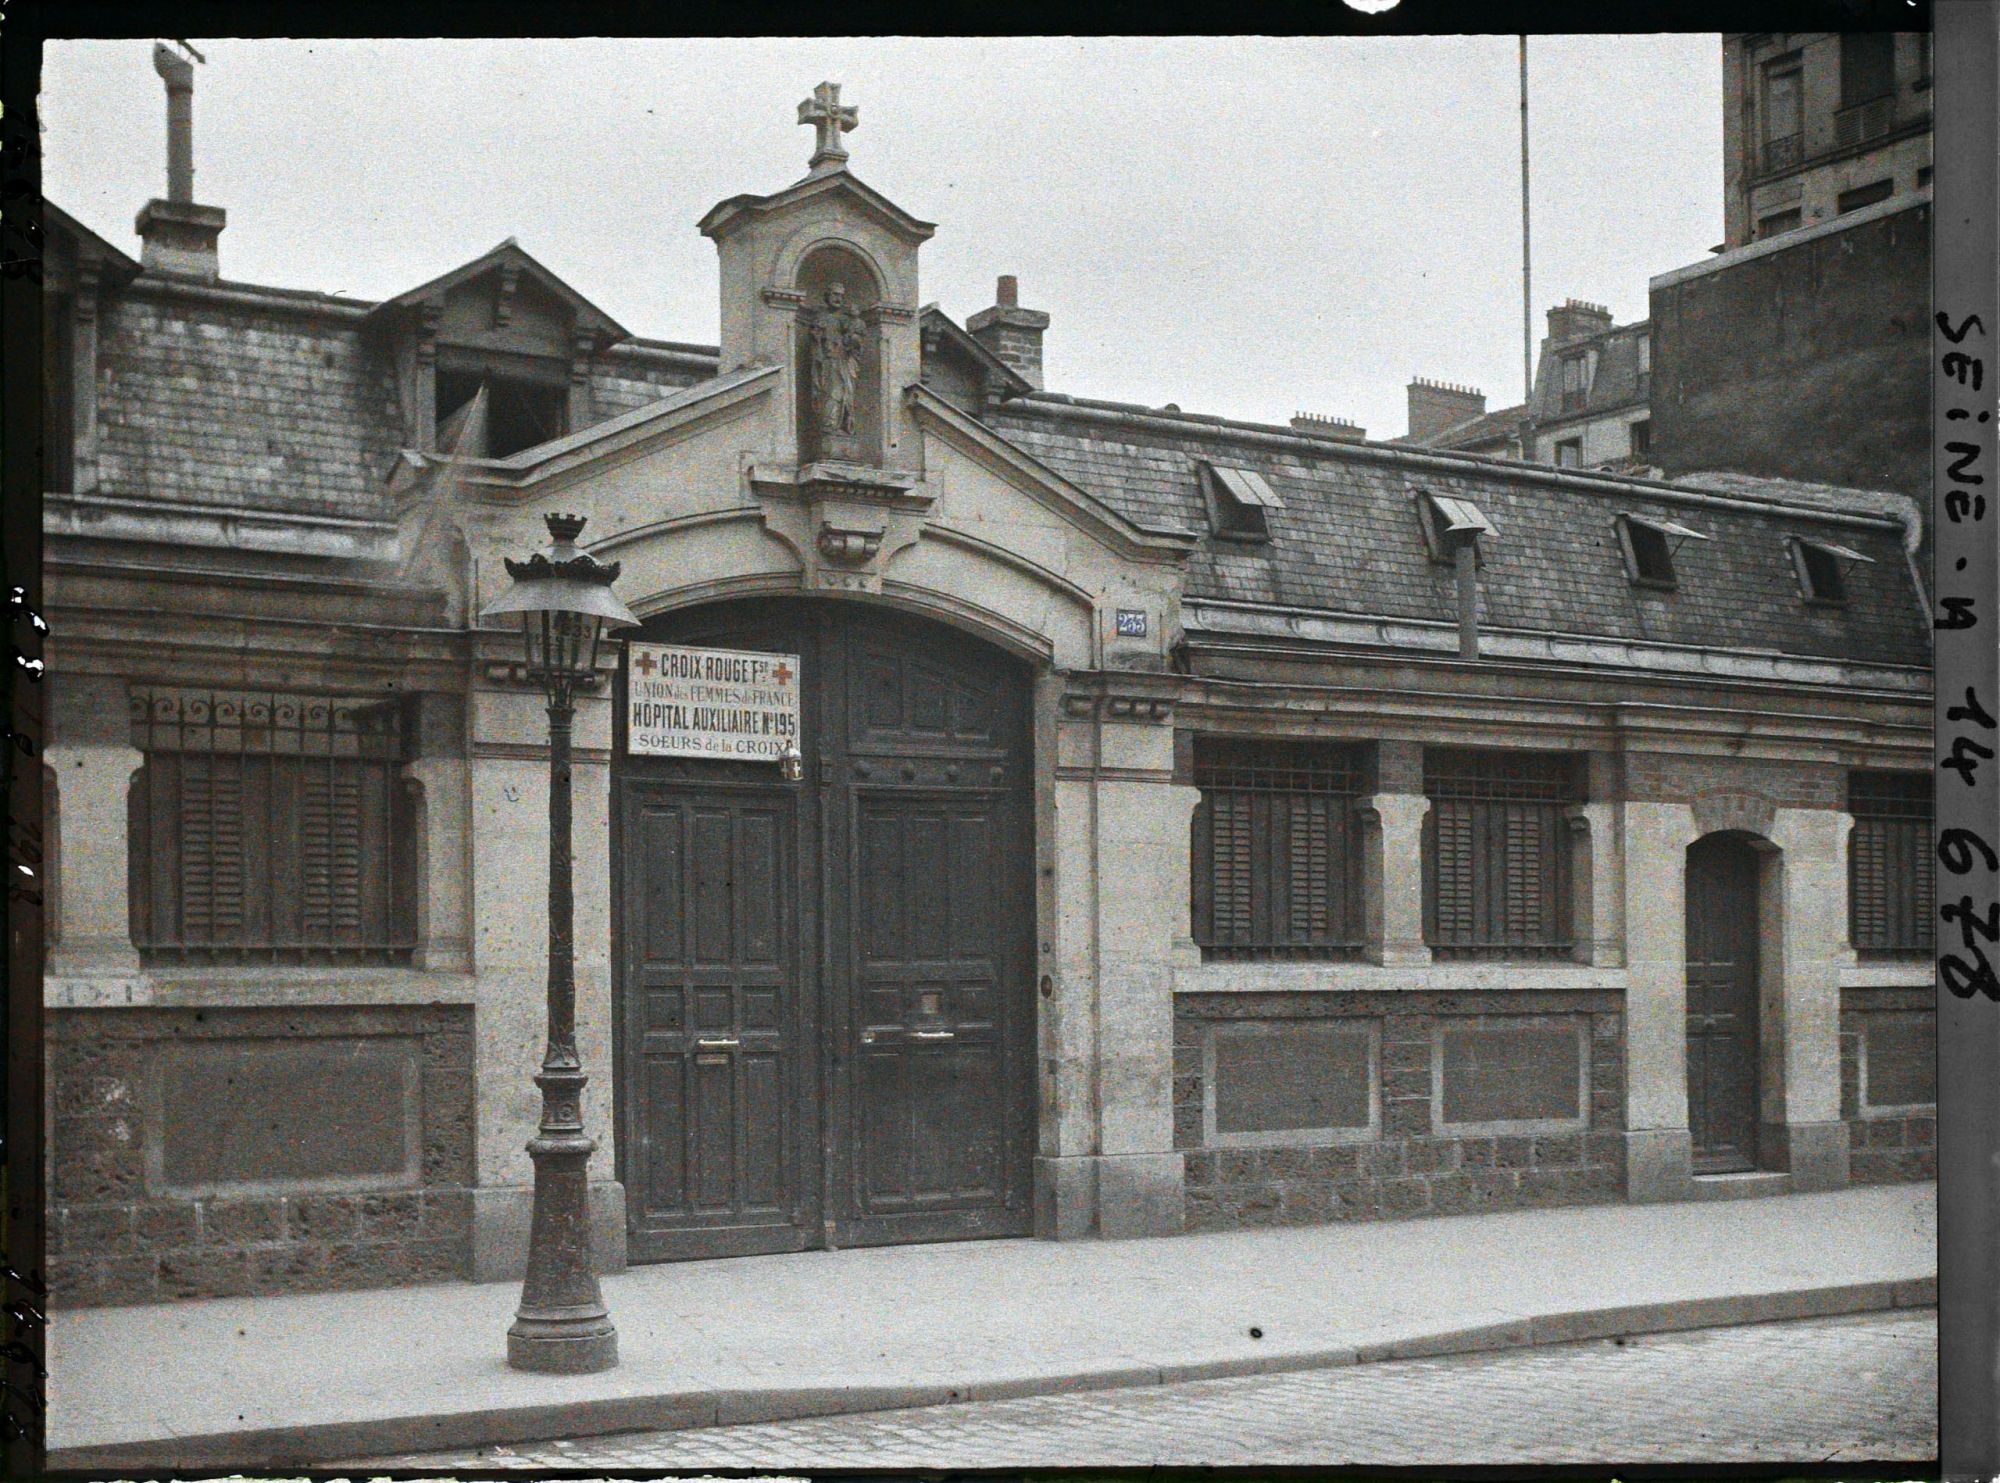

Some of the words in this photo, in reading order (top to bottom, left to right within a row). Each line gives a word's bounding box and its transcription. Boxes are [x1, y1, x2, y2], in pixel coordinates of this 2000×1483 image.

[661, 653, 701, 680] CROIX
[705, 656, 748, 683] ROUGE
[634, 681, 674, 699] UNION
[690, 685, 741, 704] FEMMES
[752, 690, 793, 707] FRANCE
[692, 707, 759, 735] AUXILIAIRE
[705, 738, 719, 751] de
[722, 739, 732, 753] la
[736, 740, 787, 757] CROIX
